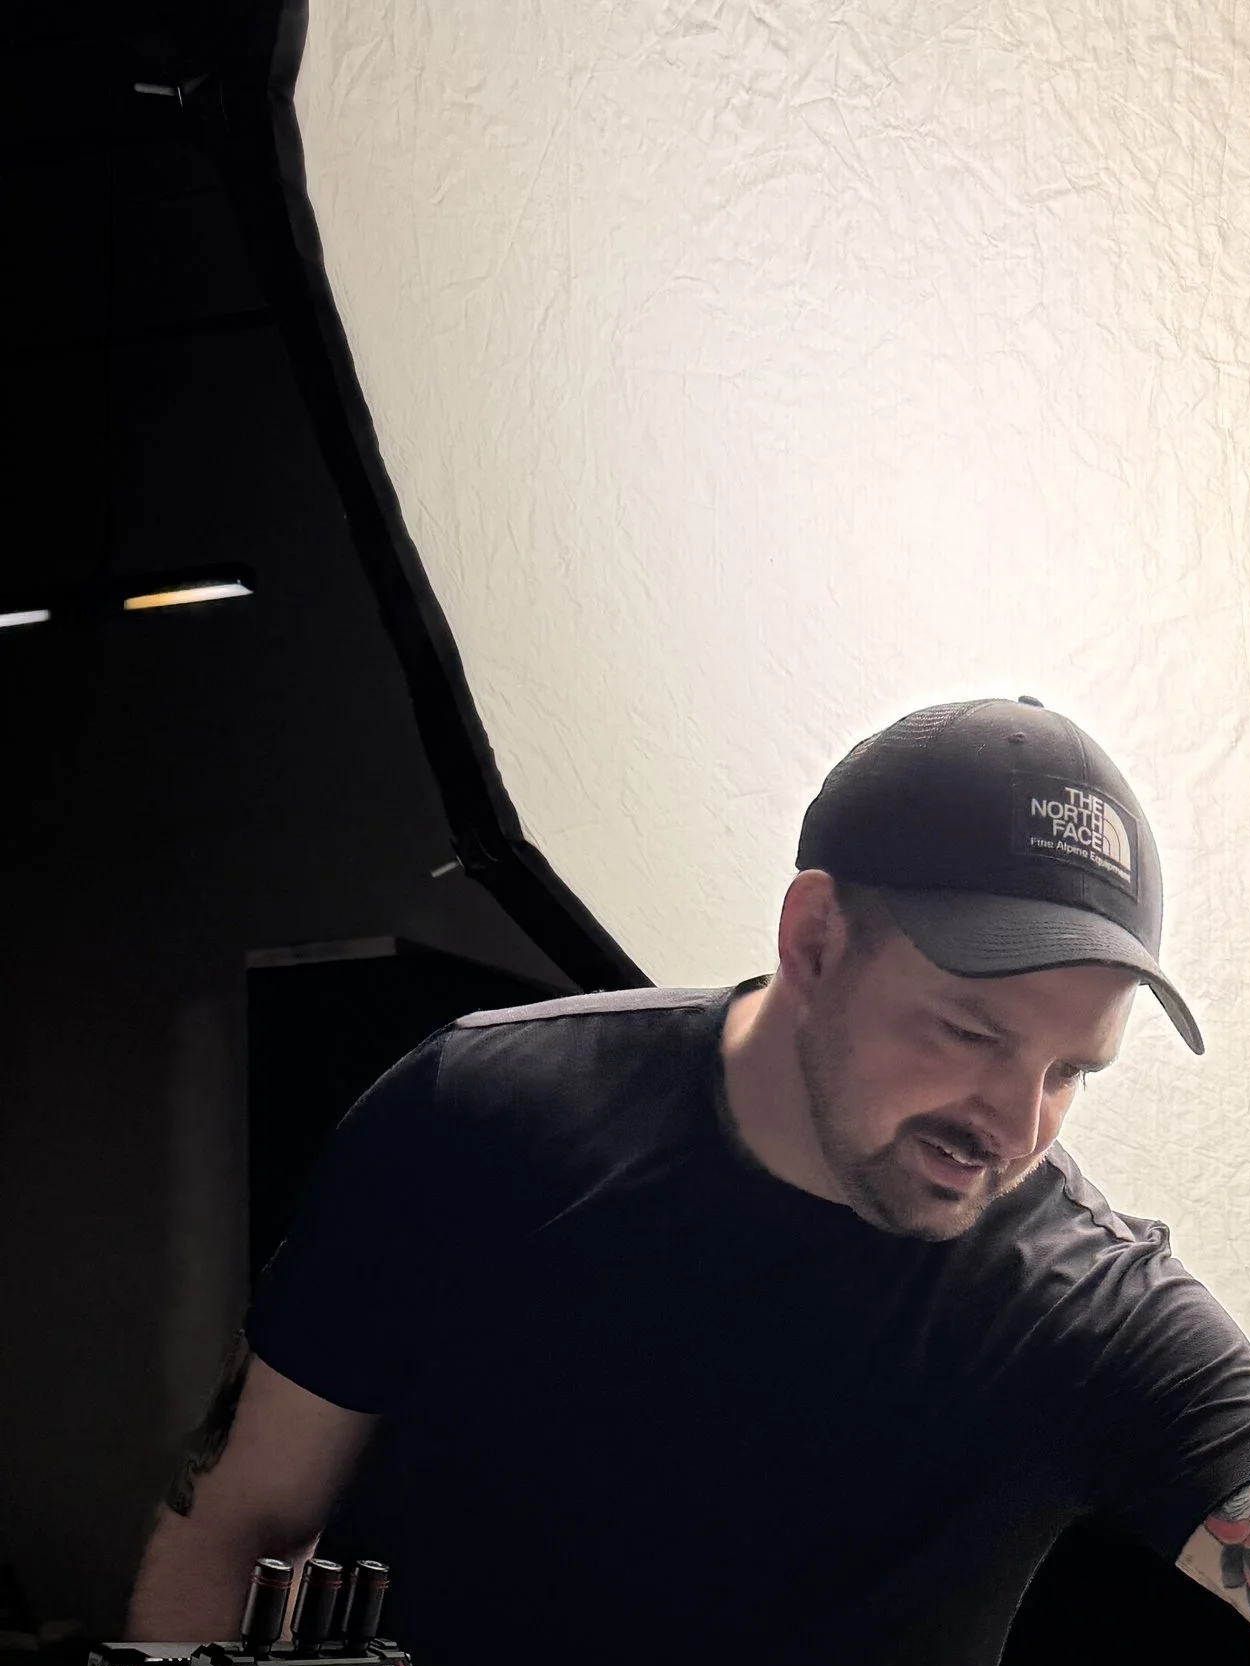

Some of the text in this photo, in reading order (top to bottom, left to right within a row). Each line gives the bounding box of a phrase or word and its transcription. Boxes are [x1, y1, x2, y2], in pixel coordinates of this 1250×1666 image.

[1031, 798, 1103, 834] NORTH
[1064, 787, 1103, 816] THE
[1052, 819, 1103, 852] FACE
[1056, 840, 1089, 859] Alpine
